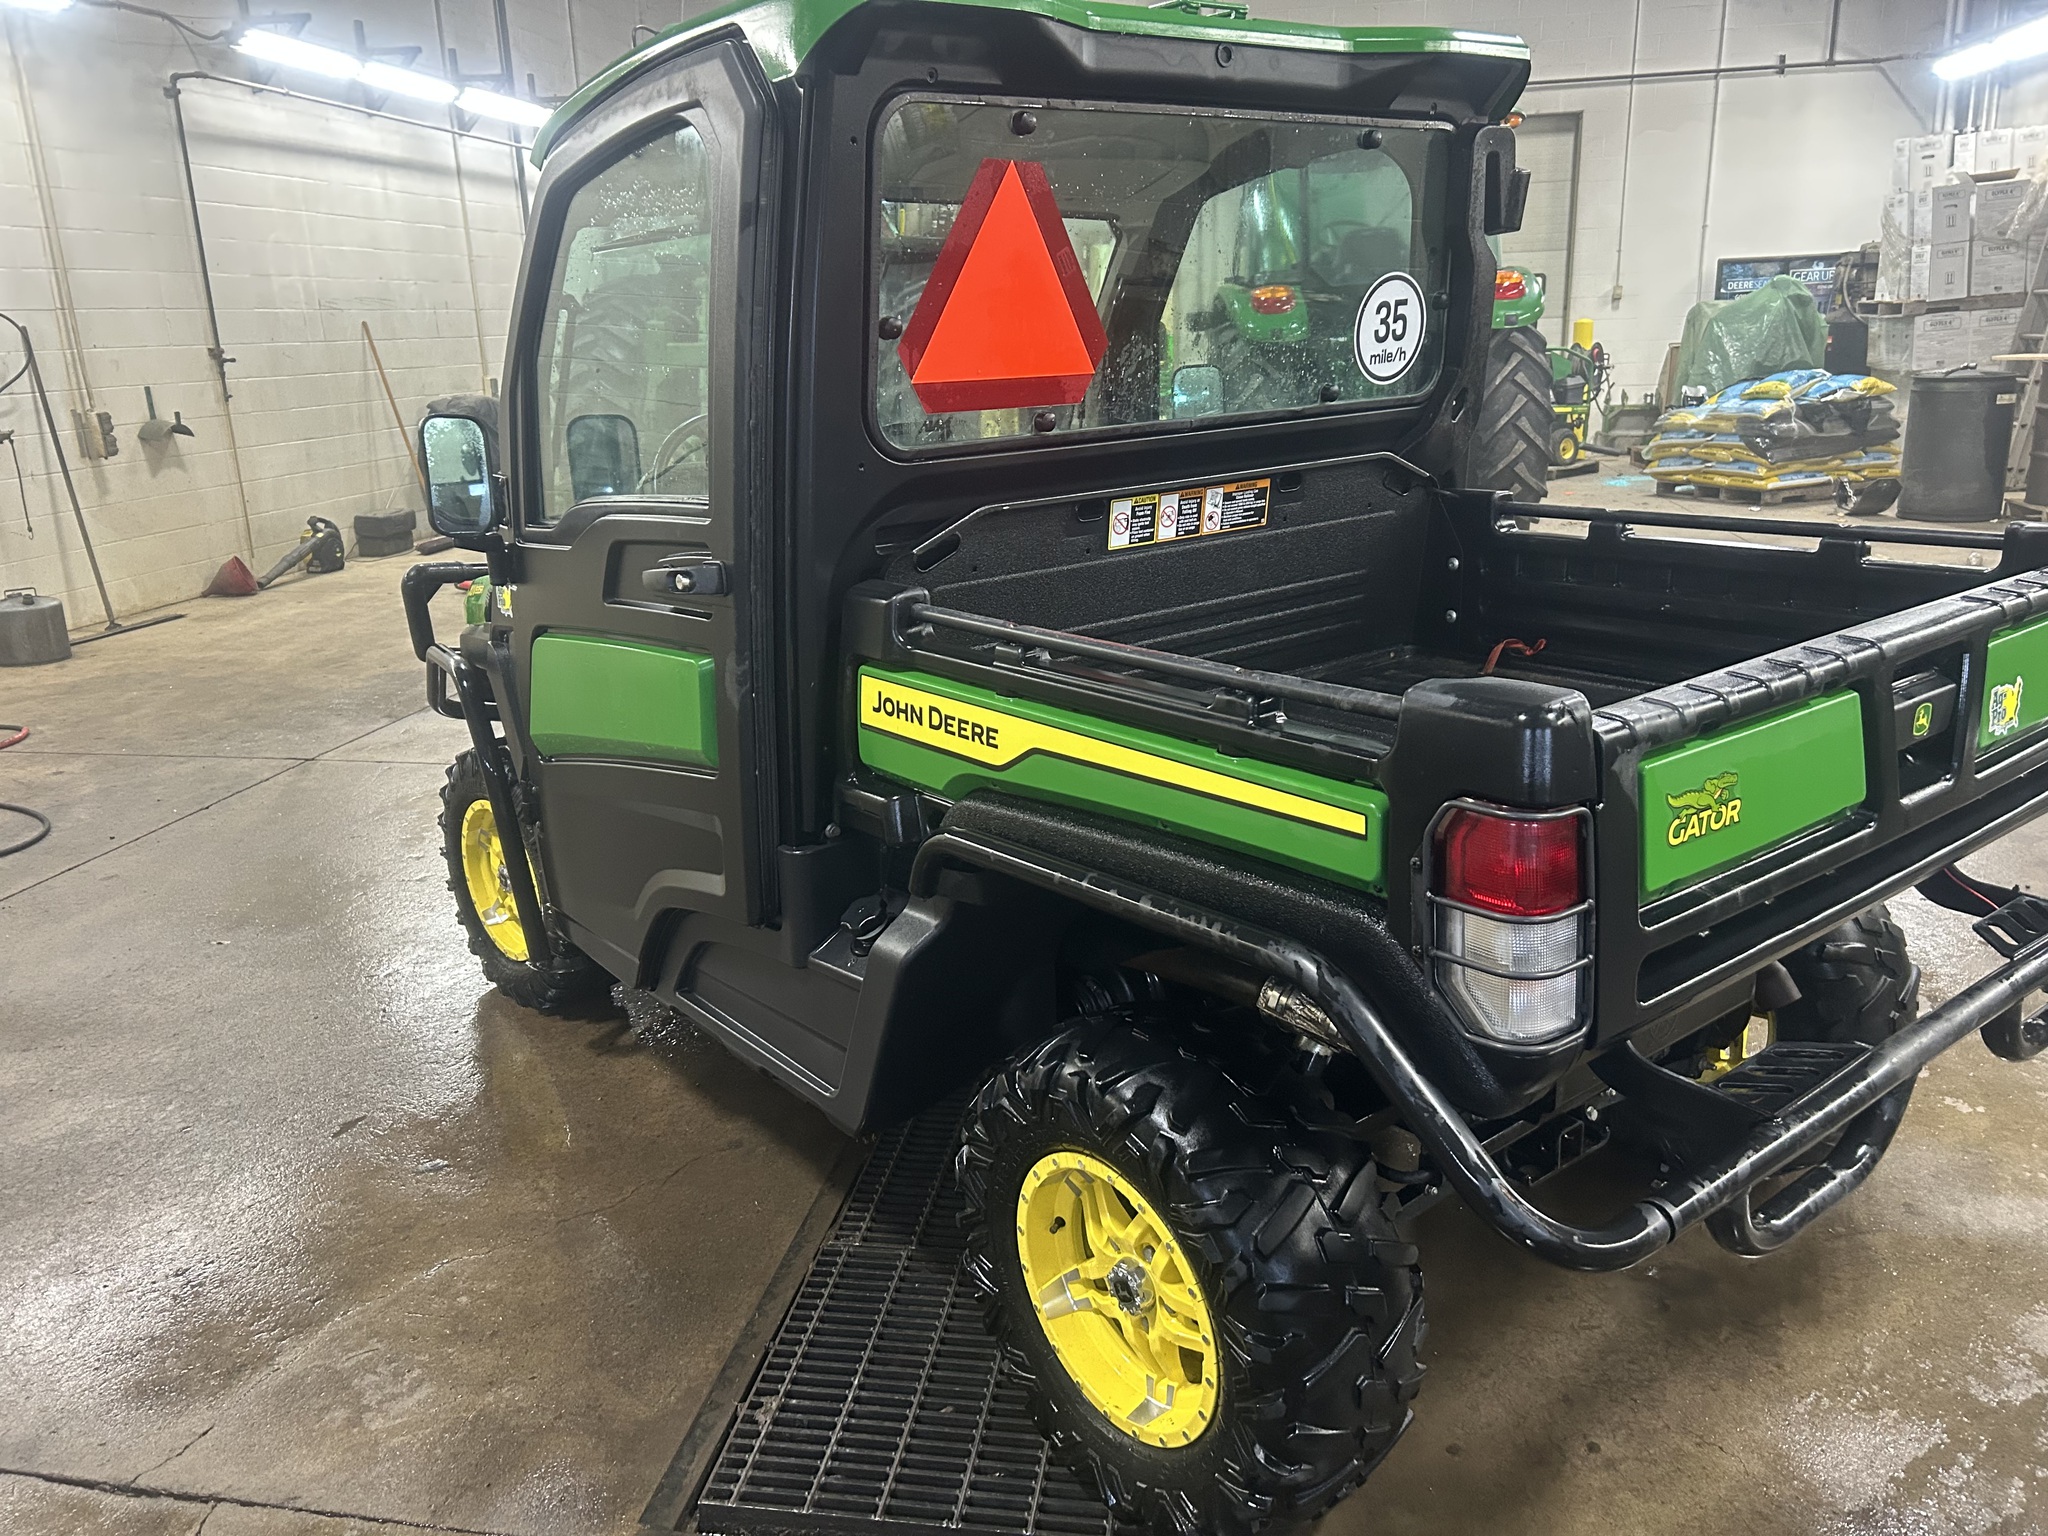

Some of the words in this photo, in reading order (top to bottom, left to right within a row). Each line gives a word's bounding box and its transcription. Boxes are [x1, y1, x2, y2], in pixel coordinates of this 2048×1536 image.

[1793, 270, 1820, 281] GEAR
[1374, 298, 1408, 344] 35
[1369, 346, 1406, 366] mile/h
[1138, 496, 1156, 504] CAUTION
[872, 690, 923, 727] JOHN
[928, 705, 999, 750] DEERE
[1668, 798, 1742, 847] GATOR
